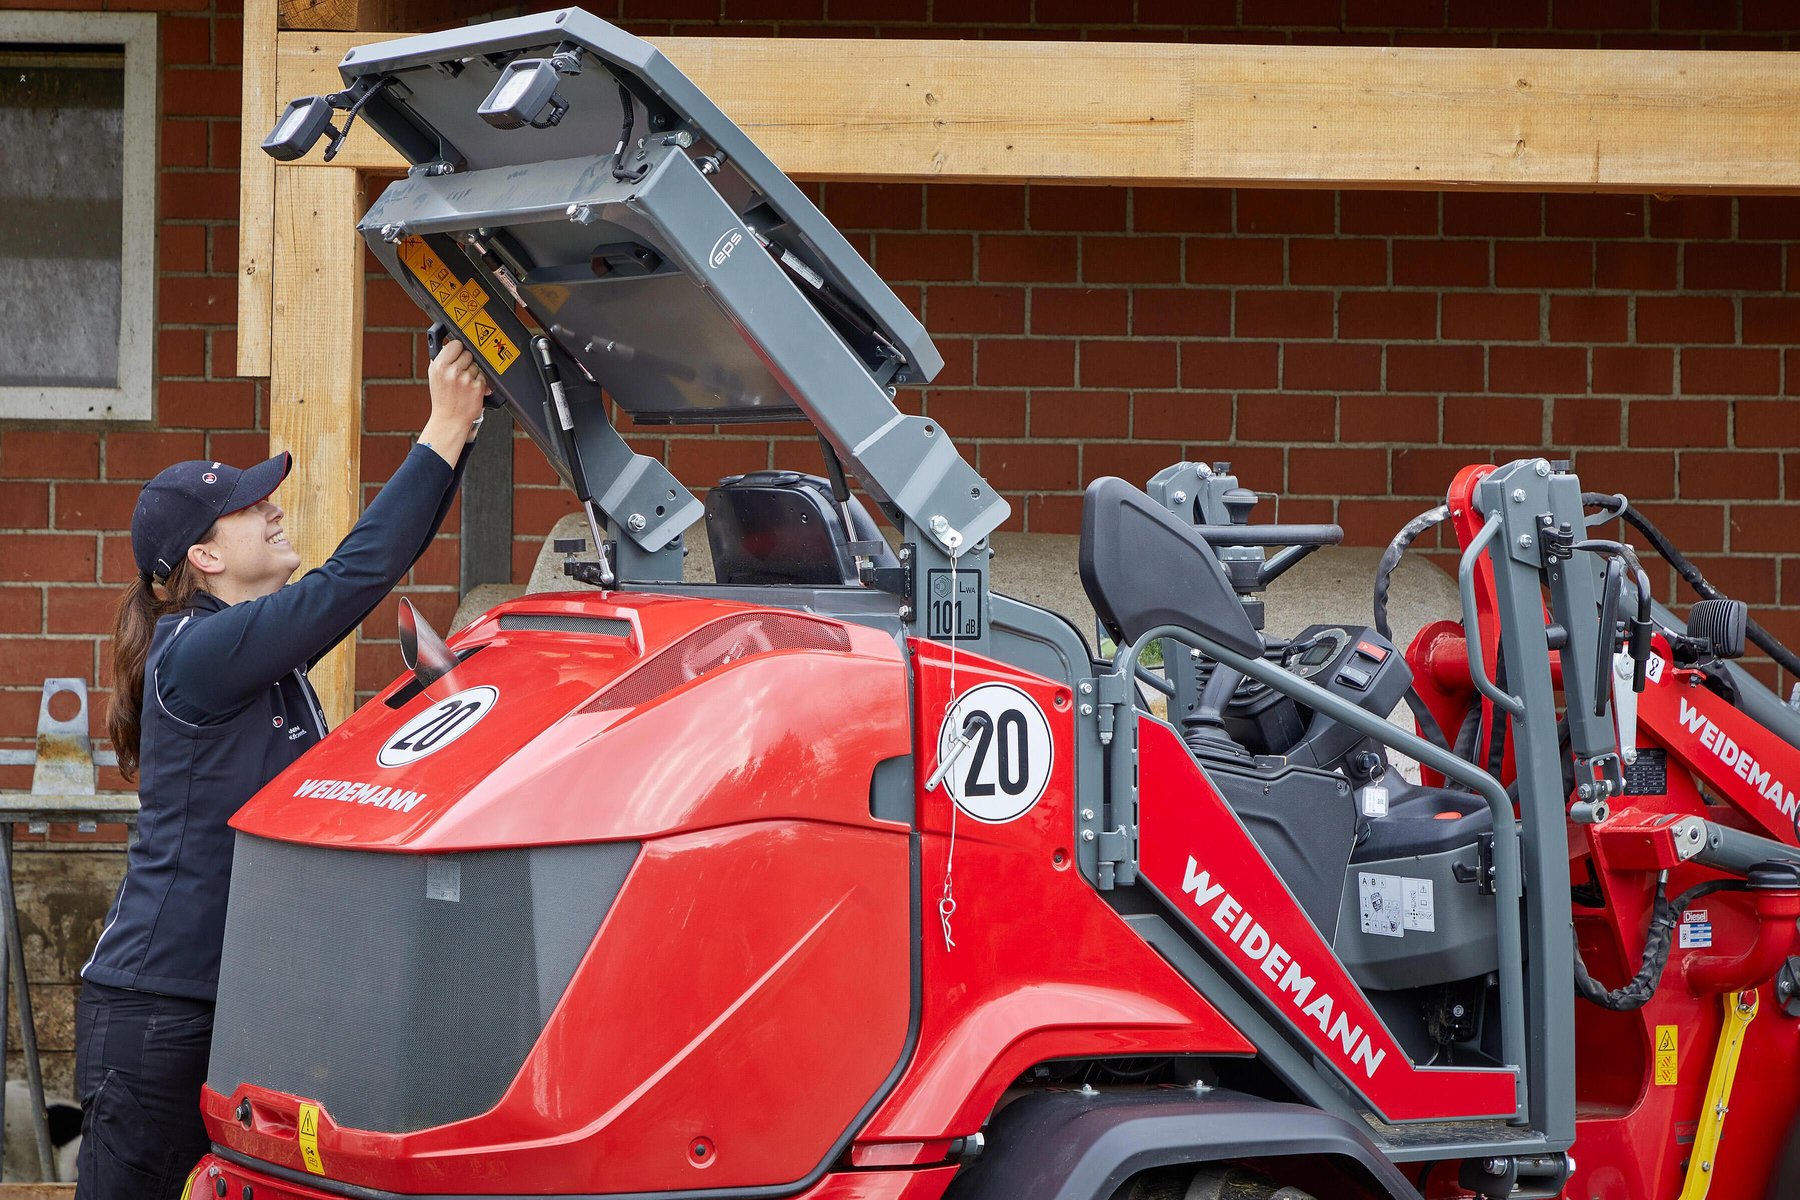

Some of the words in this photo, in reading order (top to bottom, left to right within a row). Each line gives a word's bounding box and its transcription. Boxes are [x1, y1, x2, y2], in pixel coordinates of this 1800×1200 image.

[933, 600, 962, 634] 101
[965, 619, 976, 635] dB
[389, 700, 481, 752] 20
[962, 708, 1029, 797] 20
[292, 778, 428, 813] WEIDEMANN
[1685, 911, 1706, 922] Diesel
[1181, 854, 1387, 1079] WEIDEMANN
